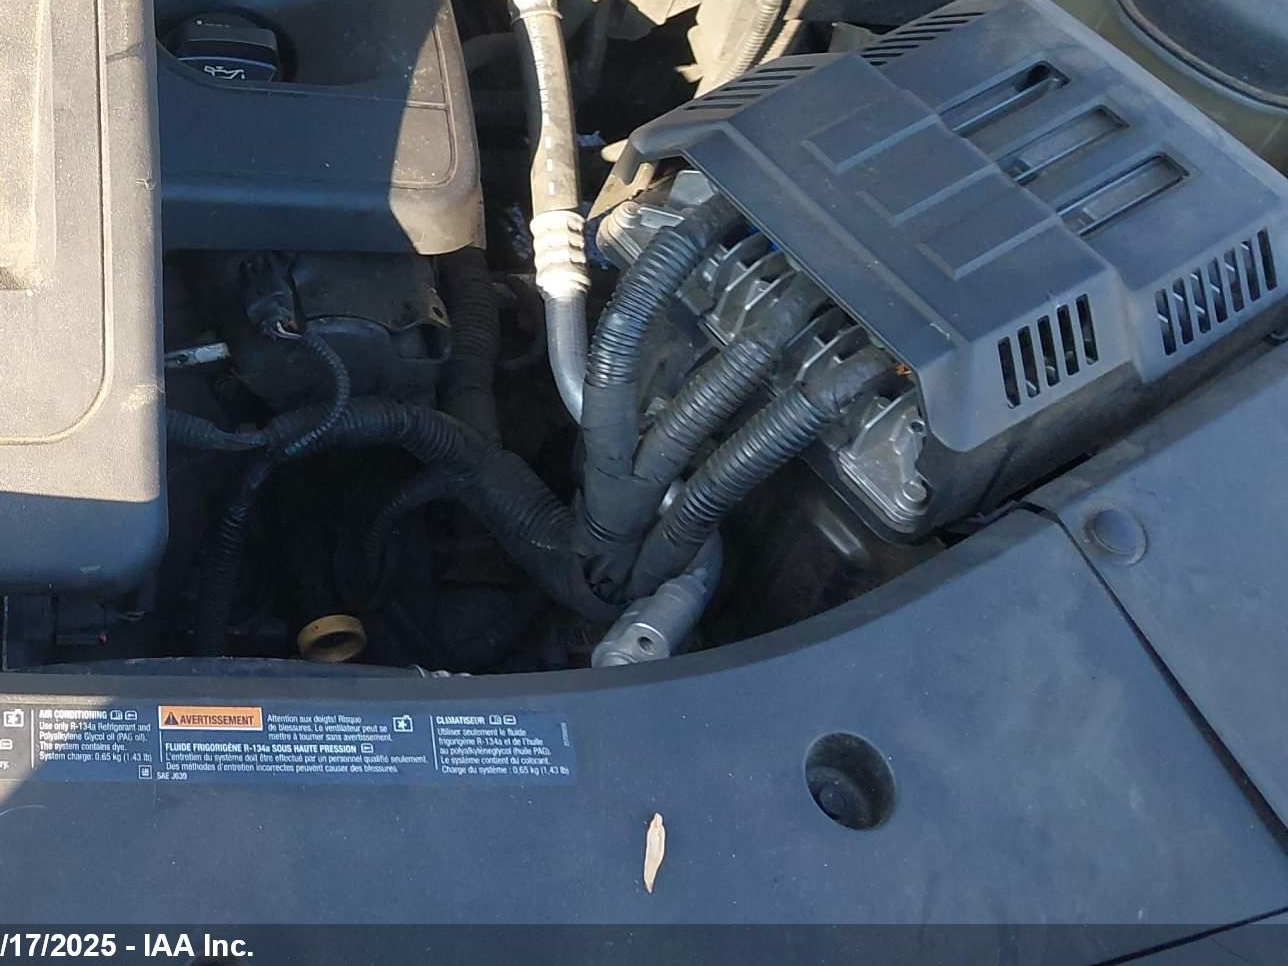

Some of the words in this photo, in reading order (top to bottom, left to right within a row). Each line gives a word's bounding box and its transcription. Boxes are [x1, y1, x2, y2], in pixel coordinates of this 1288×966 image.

[39, 709, 52, 719] AIR
[54, 709, 107, 719] CONDITIONING
[267, 714, 298, 723] Attention
[300, 715, 312, 723] aux
[338, 715, 362, 724] Risque
[180, 715, 254, 725] AVERTISSEMENT
[436, 715, 485, 725] CLIMATISEUR
[39, 721, 52, 730] Use
[54, 722, 68, 733] only
[70, 723, 96, 731] R-134a
[98, 723, 136, 733] Refrigerant
[315, 724, 324, 732] Le
[325, 724, 361, 732] ventilateur
[362, 725, 378, 733] peut
[437, 727, 461, 736] Utiliser
[463, 728, 498, 736] seulement
[507, 728, 527, 736] fluide
[39, 732, 82, 741] Polyalkylene
[84, 733, 105, 742] Glycol
[299, 733, 324, 741] tourner
[477, 737, 502, 746] R-134a
[512, 737, 521, 745] de
[40, 741, 52, 750] The
[54, 742, 79, 752] system
[81, 743, 110, 751] contains
[165, 742, 191, 751] FLUIDE
[193, 742, 241, 752] FRIGORIGÈNE
[243, 744, 270, 752] R-134a
[272, 744, 292, 753] SOUS
[293, 744, 318, 753] HAUTE
[320, 744, 357, 753] PRESSION
[39, 752, 65, 761] System
[67, 753, 93, 762] charge:
[113, 753, 122, 762] kg
[165, 753, 202, 761] L'entretien
[204, 753, 213, 762] du
[215, 754, 243, 763] système
[245, 754, 258, 762] doit
[260, 754, 273, 762] être
[275, 754, 303, 763] effectué
[305, 755, 316, 764] par
[329, 755, 362, 763] personnel
[363, 755, 389, 764] qualifié
[441, 756, 449, 764] Le
[451, 756, 480, 765] système
[482, 756, 508, 764] contient
[510, 756, 519, 764] du
[166, 762, 180, 770] Des
[181, 763, 216, 771] méthodes
[217, 763, 254, 771] d'entretien
[256, 764, 294, 772] incorrectes
[296, 765, 323, 773] peuvent
[350, 764, 363, 772] des
[442, 766, 466, 775] Charge
[468, 766, 477, 774] du
[479, 766, 507, 776] système
[530, 767, 539, 776] kg
[157, 772, 169, 780] SAE
